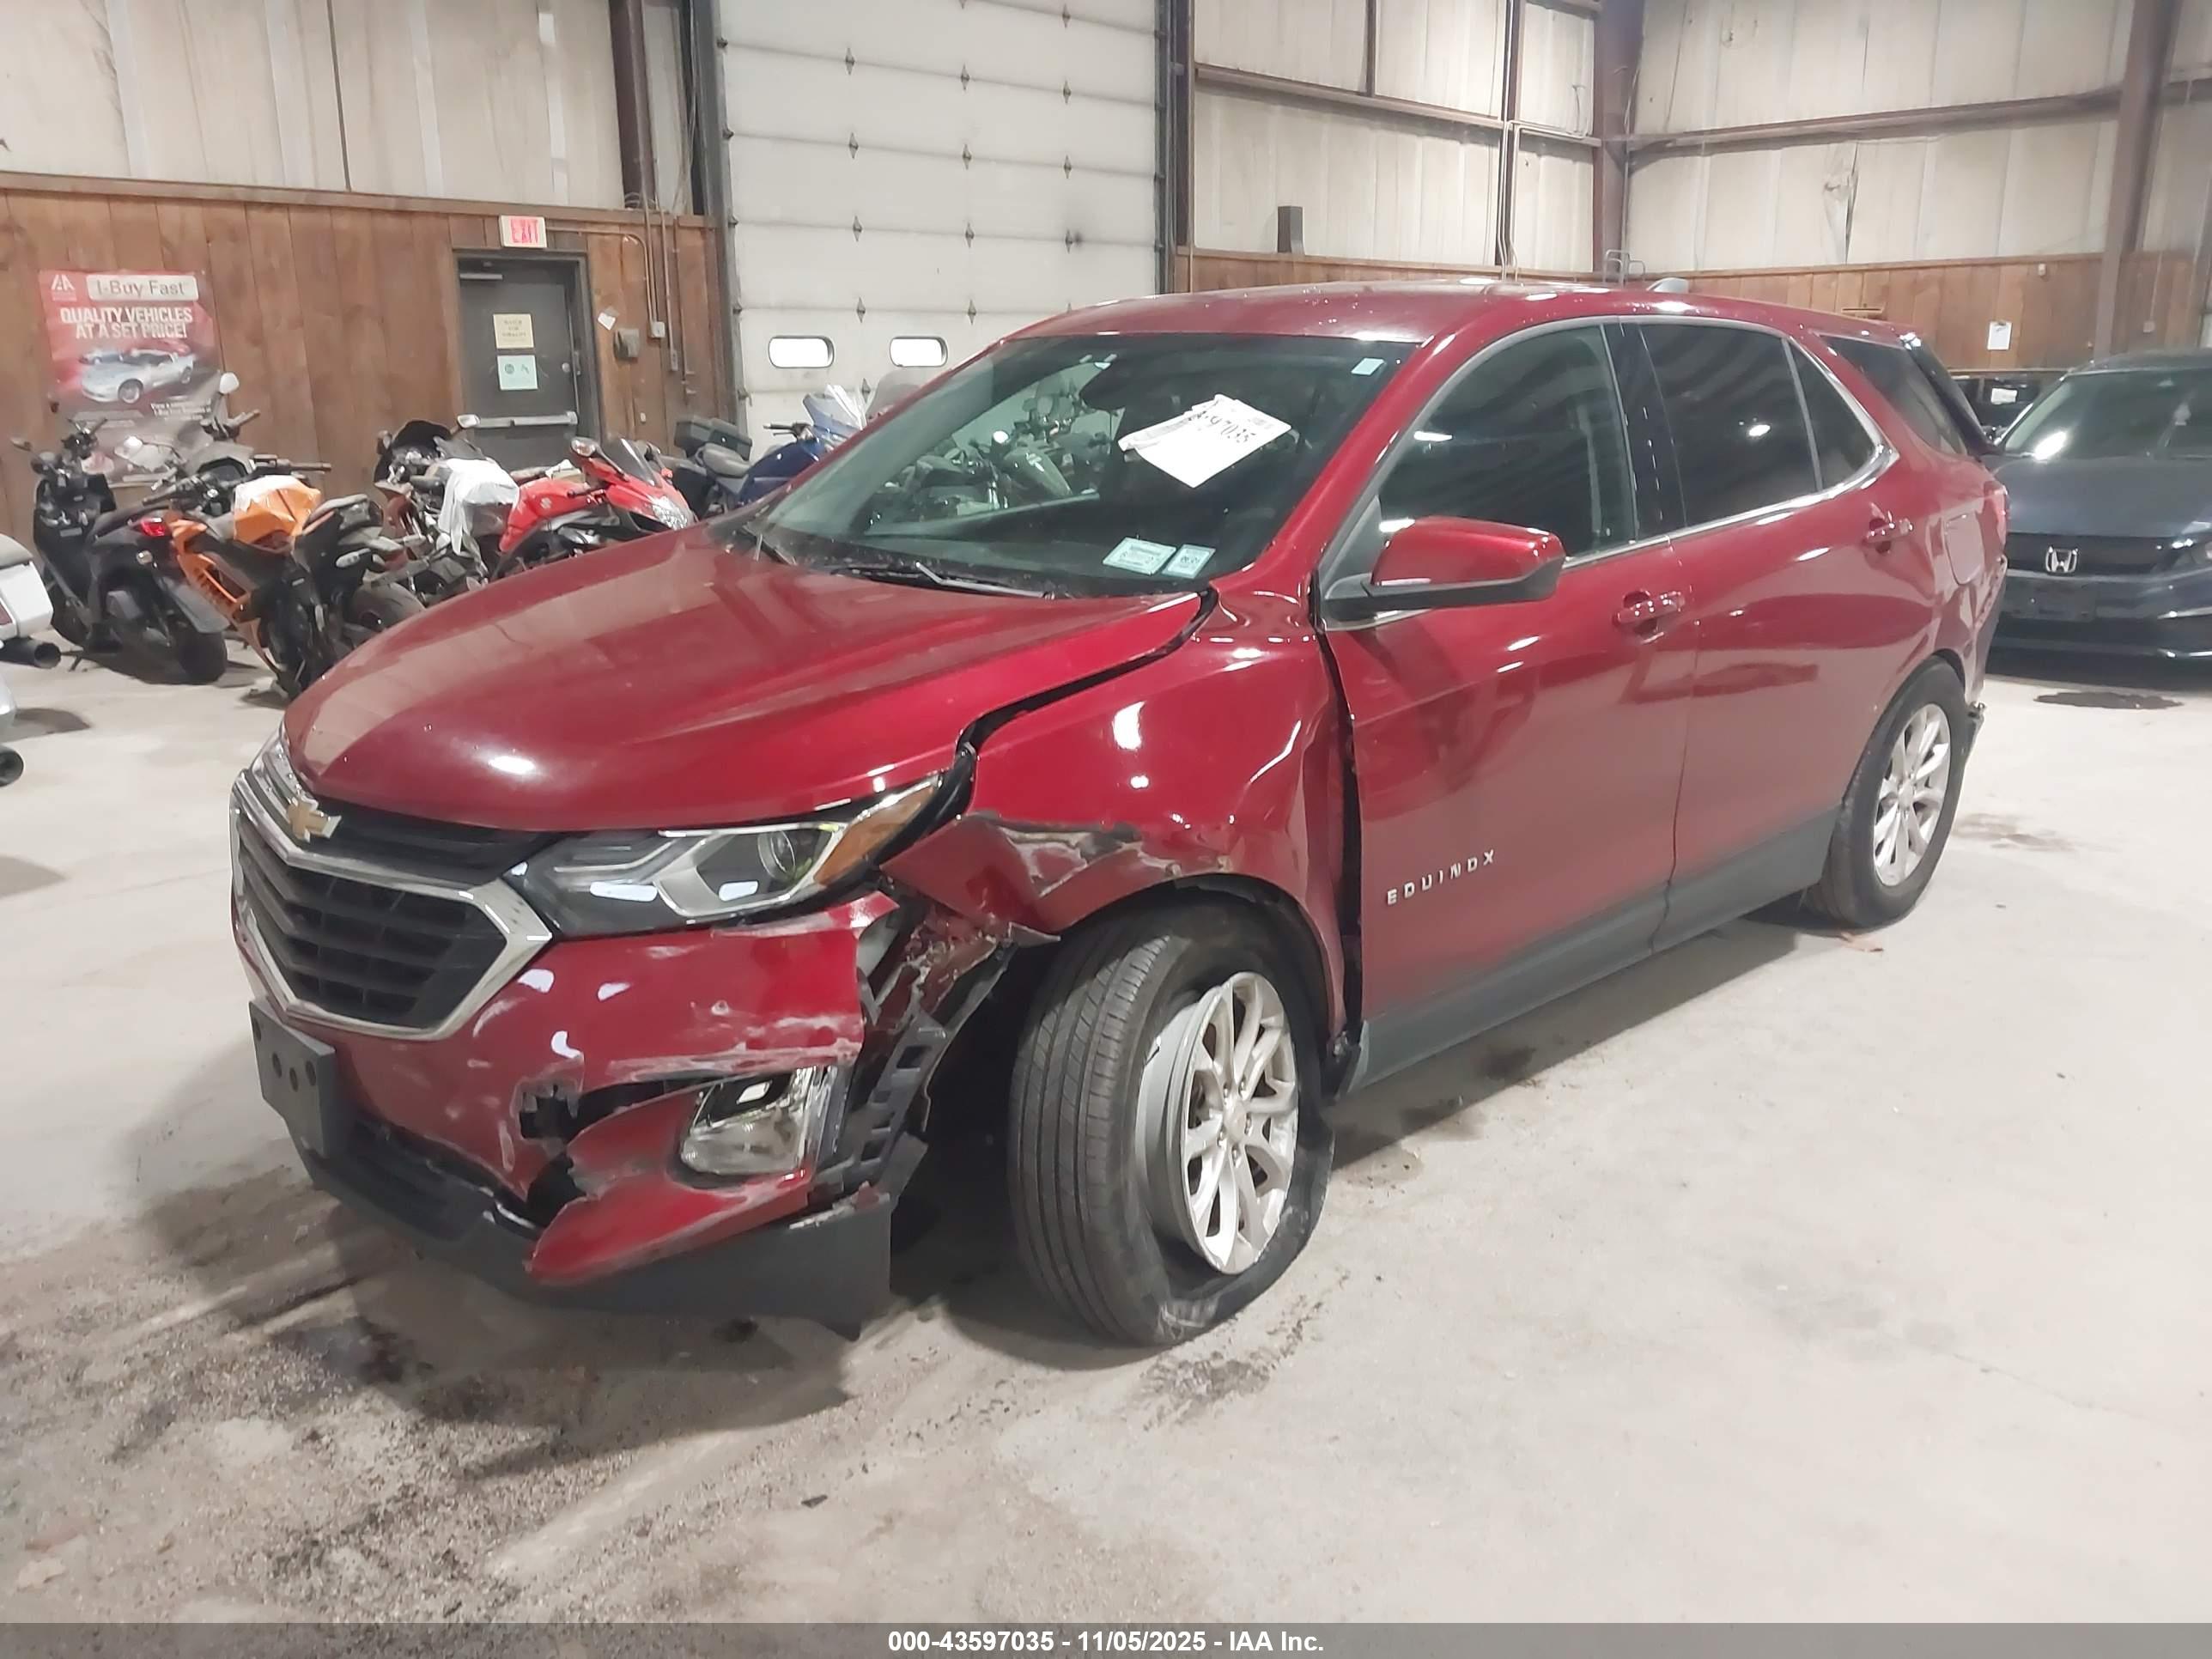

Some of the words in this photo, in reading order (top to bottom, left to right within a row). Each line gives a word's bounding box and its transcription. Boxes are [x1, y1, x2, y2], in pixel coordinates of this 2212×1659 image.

[510, 219, 538, 244] EXIT
[96, 279, 144, 298] I-Buy
[149, 280, 185, 296] Fast
[60, 307, 123, 323] QUALITY
[124, 307, 193, 323] VEHICLES
[75, 323, 98, 338] AT
[95, 323, 110, 338] A
[112, 323, 140, 338] SET
[141, 322, 188, 338] PRICE!
[1386, 848, 1494, 905] EQUINOX
